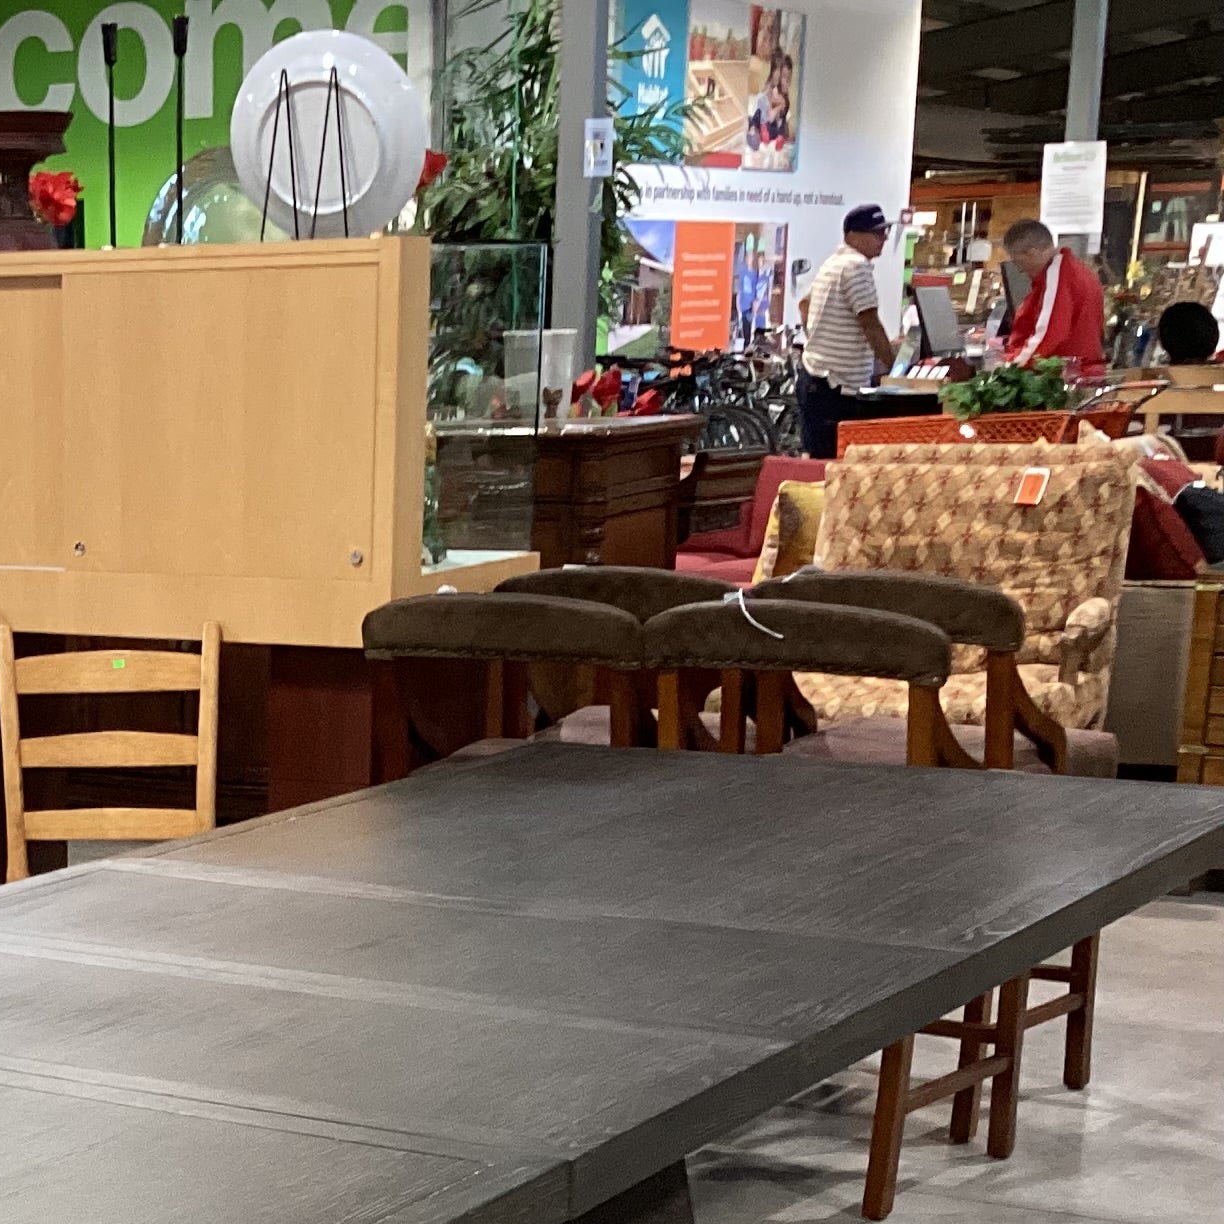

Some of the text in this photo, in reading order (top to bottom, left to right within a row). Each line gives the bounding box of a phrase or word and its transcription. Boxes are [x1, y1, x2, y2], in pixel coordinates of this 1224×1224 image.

[653, 184, 696, 205] partnership
[712, 185, 737, 202] families
[747, 188, 762, 203] need
[764, 188, 771, 203] of
